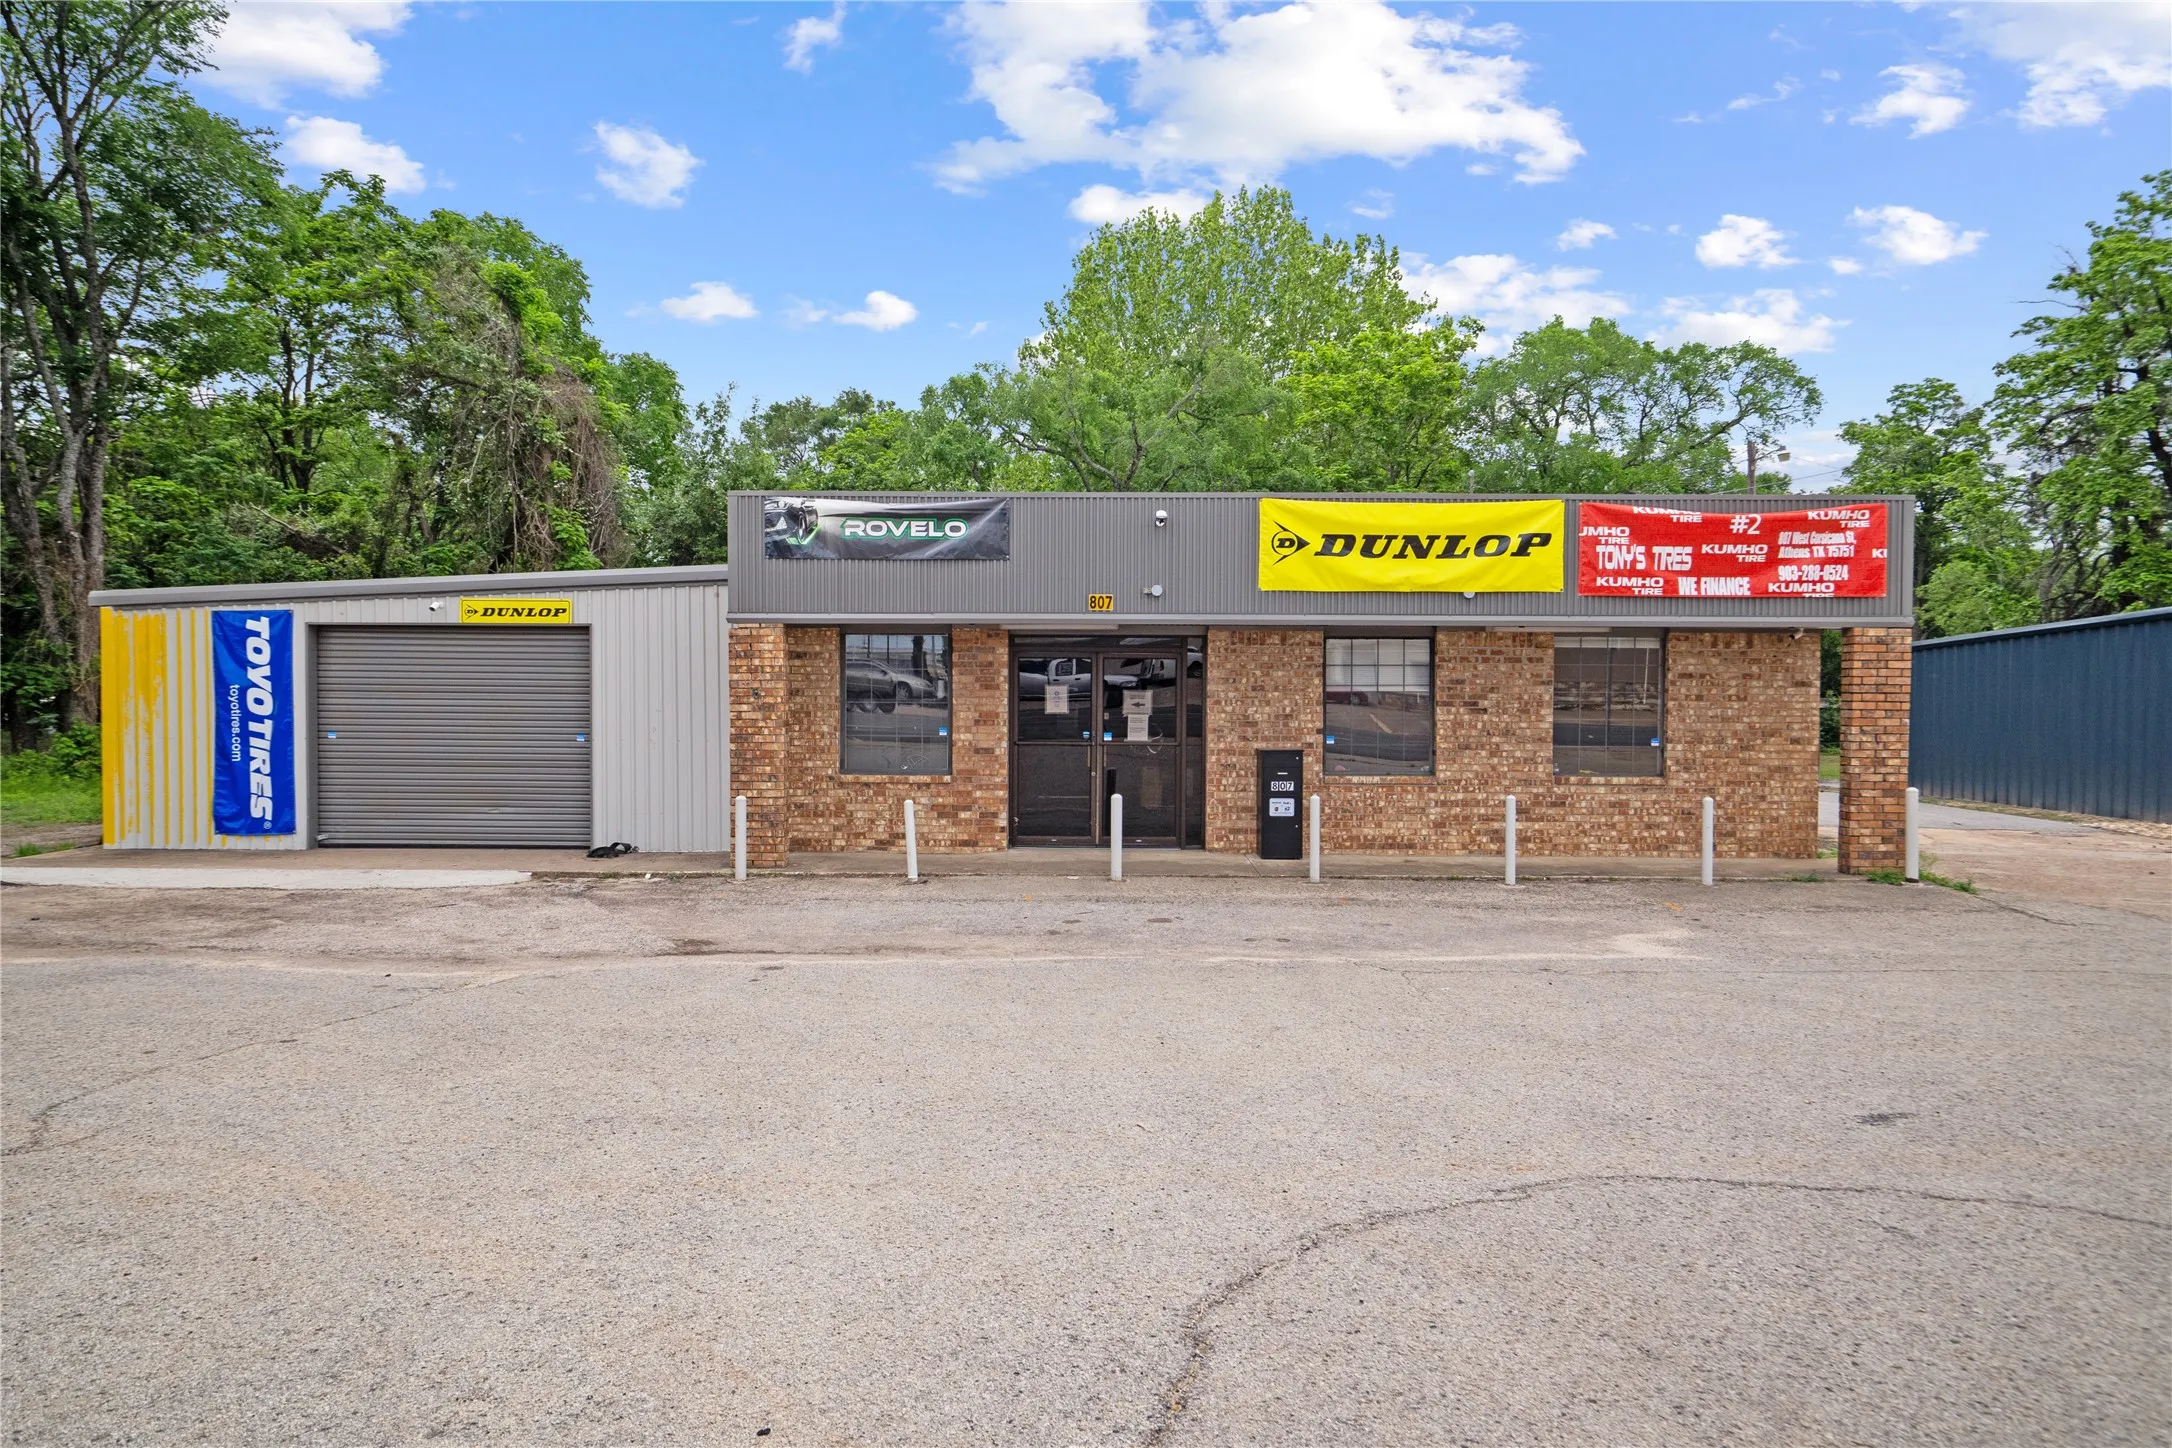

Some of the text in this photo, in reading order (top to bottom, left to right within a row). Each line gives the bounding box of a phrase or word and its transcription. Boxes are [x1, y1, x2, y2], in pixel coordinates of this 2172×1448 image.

[1670, 514, 1702, 523] TIRE
[1807, 510, 1870, 520] KUMHO
[844, 520, 967, 537] ROVELO
[1730, 514, 1762, 535] #2
[1840, 520, 1871, 528] TIRE
[1314, 533, 1552, 559] DUNLOP
[1598, 537, 1630, 545] TIRE
[1701, 544, 1768, 554] KUMHO
[1778, 546, 1811, 558] Athens
[1812, 546, 1825, 558] TX
[1596, 543, 1693, 571] TONY'S TIRES
[1736, 554, 1767, 563] TIRE
[1596, 577, 1664, 587] KUMHO
[1678, 577, 1751, 596] WE FINANCE
[1768, 582, 1835, 593] KUMHO
[1632, 587, 1663, 595] TIRE
[1089, 595, 1113, 609] 807
[480, 607, 567, 618] DUNLOP
[228, 684, 241, 762] toyotires.com
[1271, 781, 1294, 791] 807
